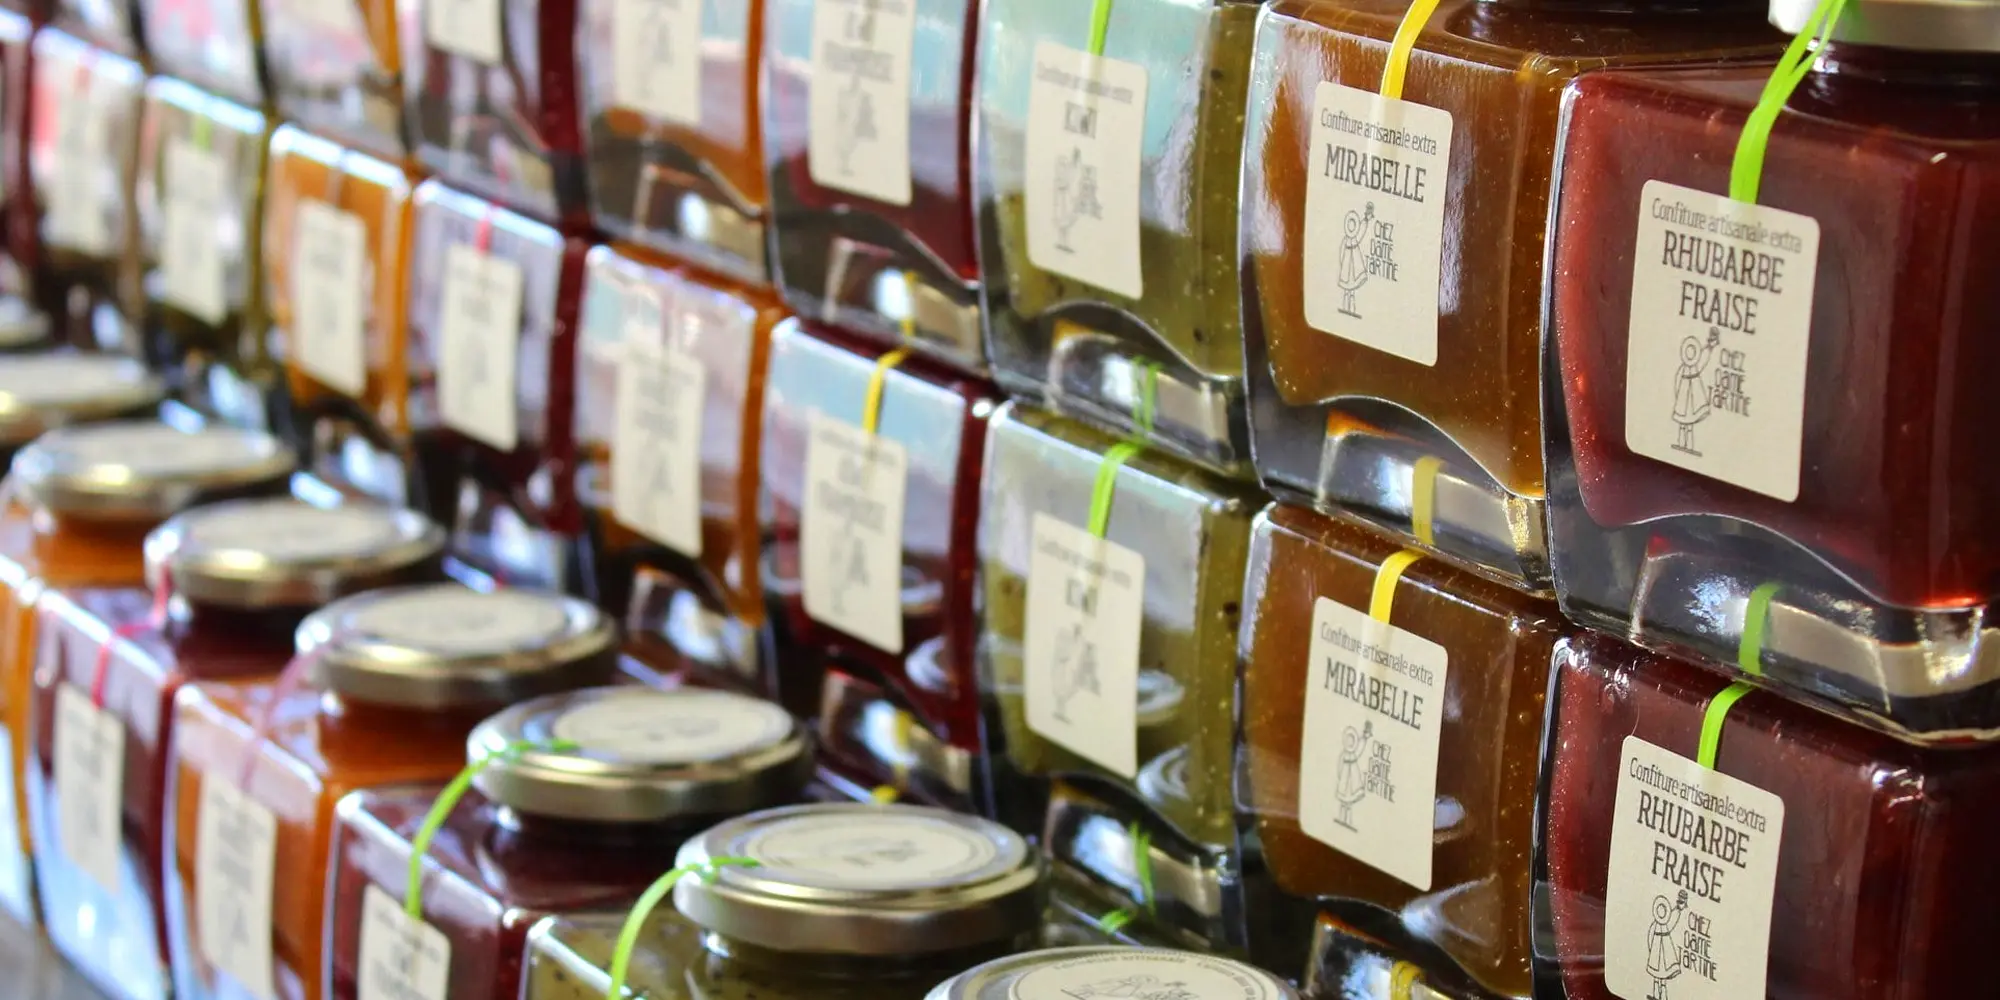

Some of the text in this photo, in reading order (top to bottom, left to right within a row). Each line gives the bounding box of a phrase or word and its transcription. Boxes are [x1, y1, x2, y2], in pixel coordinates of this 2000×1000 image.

[1321, 107, 1437, 155] Confiture artisanale extra
[1324, 144, 1427, 203] MIRABELLE
[1373, 219, 1394, 242] CHEZ
[1652, 198, 1802, 254] Confiture artisanale extra
[1662, 230, 1785, 294] RHUBARBE
[1679, 281, 1758, 335] FRAISE
[1720, 348, 1745, 370] CHEZ
[1320, 621, 1433, 686] Confiture artisanale extra
[1324, 657, 1423, 730] MIRABELLE
[1630, 757, 1766, 833] Confiture artisanale extra
[1637, 790, 1749, 868] RHUBARBE
[1652, 841, 1724, 903] FRAISE
[1688, 912, 1711, 938] CHEZ
